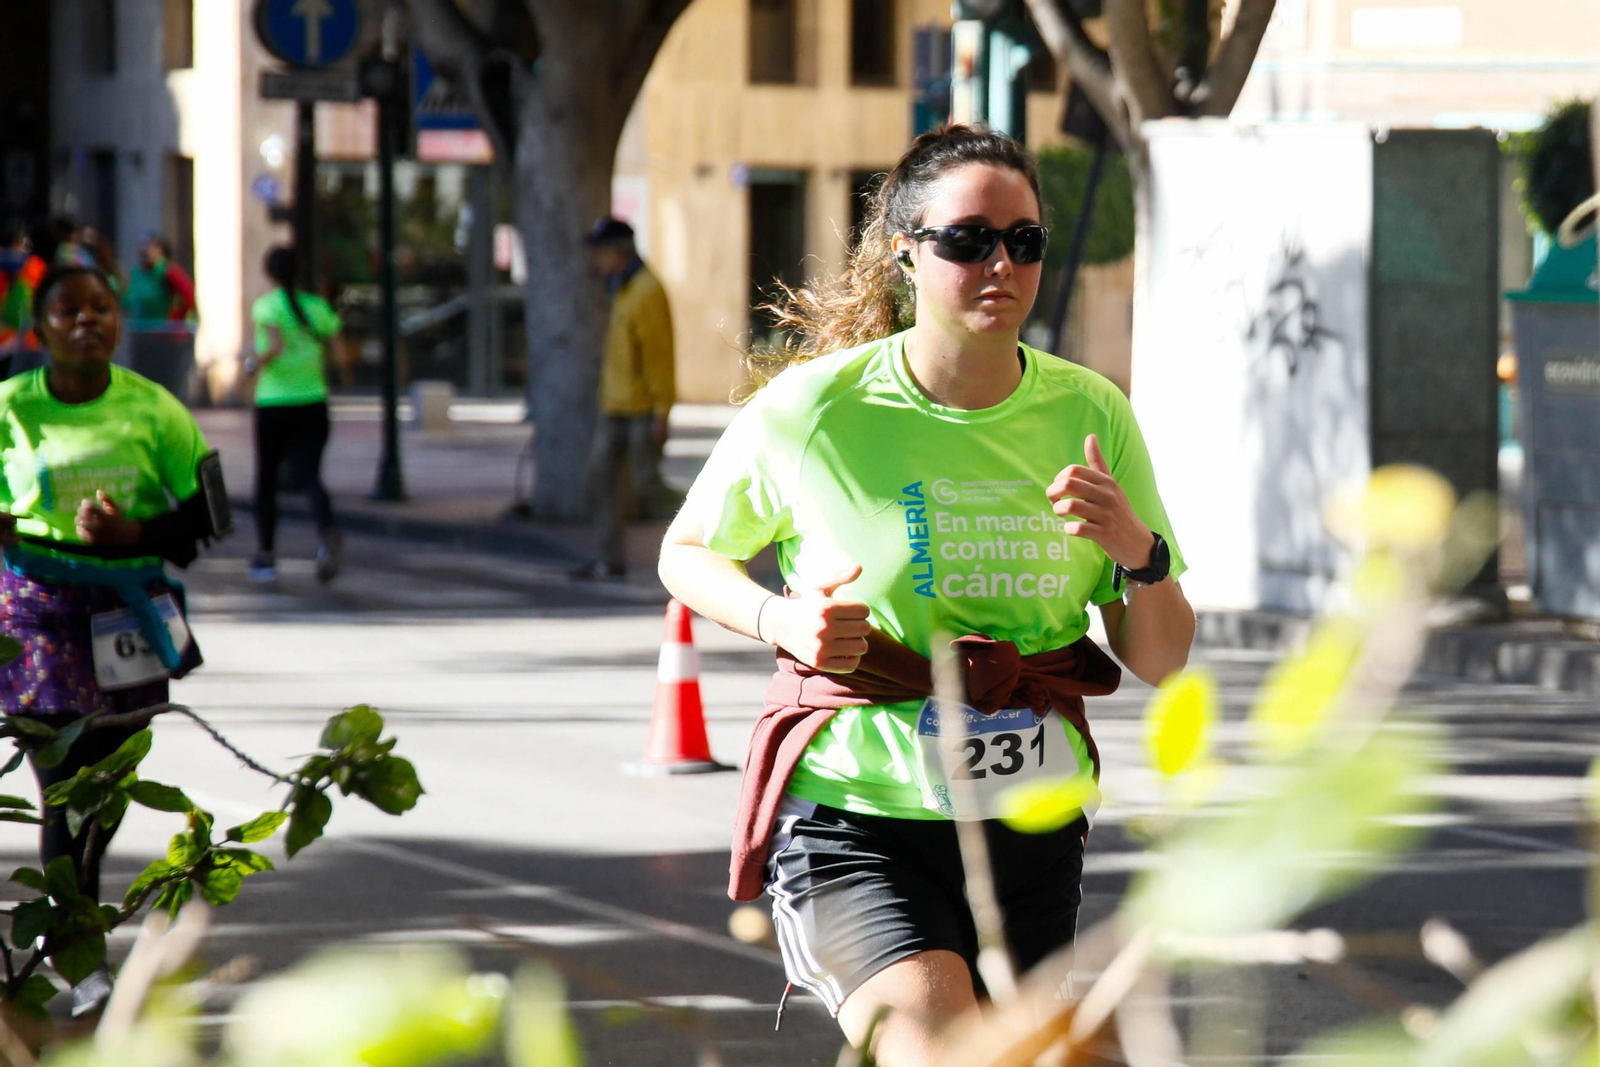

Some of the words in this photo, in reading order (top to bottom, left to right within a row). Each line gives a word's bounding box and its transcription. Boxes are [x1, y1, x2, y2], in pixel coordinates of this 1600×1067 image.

[898, 480, 937, 599] ALMERÍA
[935, 511, 968, 533] En
[975, 511, 1068, 533] marcha
[940, 535, 1039, 561] contra
[1046, 536, 1071, 562] el
[942, 564, 1071, 599] cáncer
[951, 722, 1045, 780] 231
